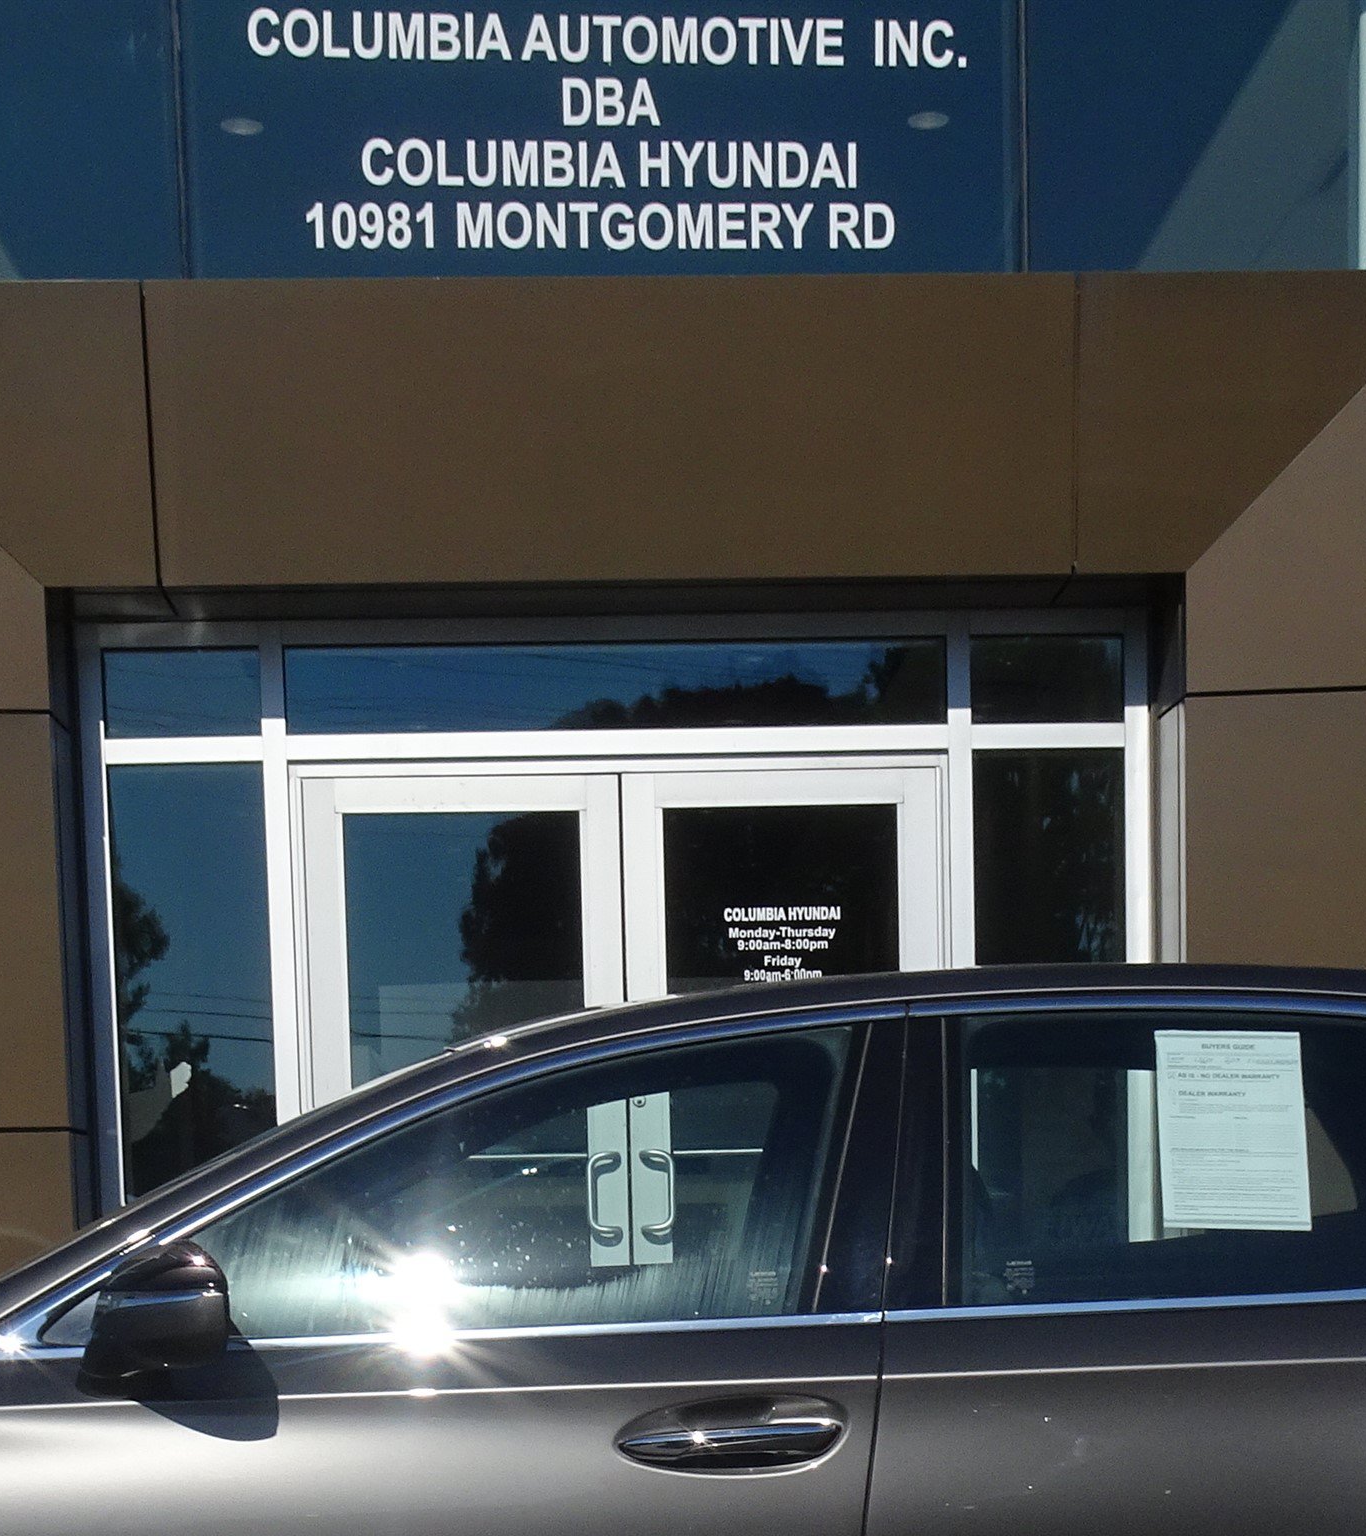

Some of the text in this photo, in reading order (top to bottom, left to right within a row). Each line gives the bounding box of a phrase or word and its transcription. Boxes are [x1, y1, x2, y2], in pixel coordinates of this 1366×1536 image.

[247, 8, 968, 68] COLUMBIA AUTOMOTIVE INC.
[562, 78, 660, 126] DBA
[361, 138, 858, 189] COLUMBIA HYUNDAI
[305, 202, 895, 251] 10981 MONTGOMERY RD
[724, 906, 841, 922] COLUMBIA HYUNDAI
[728, 926, 836, 940] Monday-Thursday
[737, 938, 829, 951] 9:00am-8:00pm
[764, 955, 802, 968] Friday
